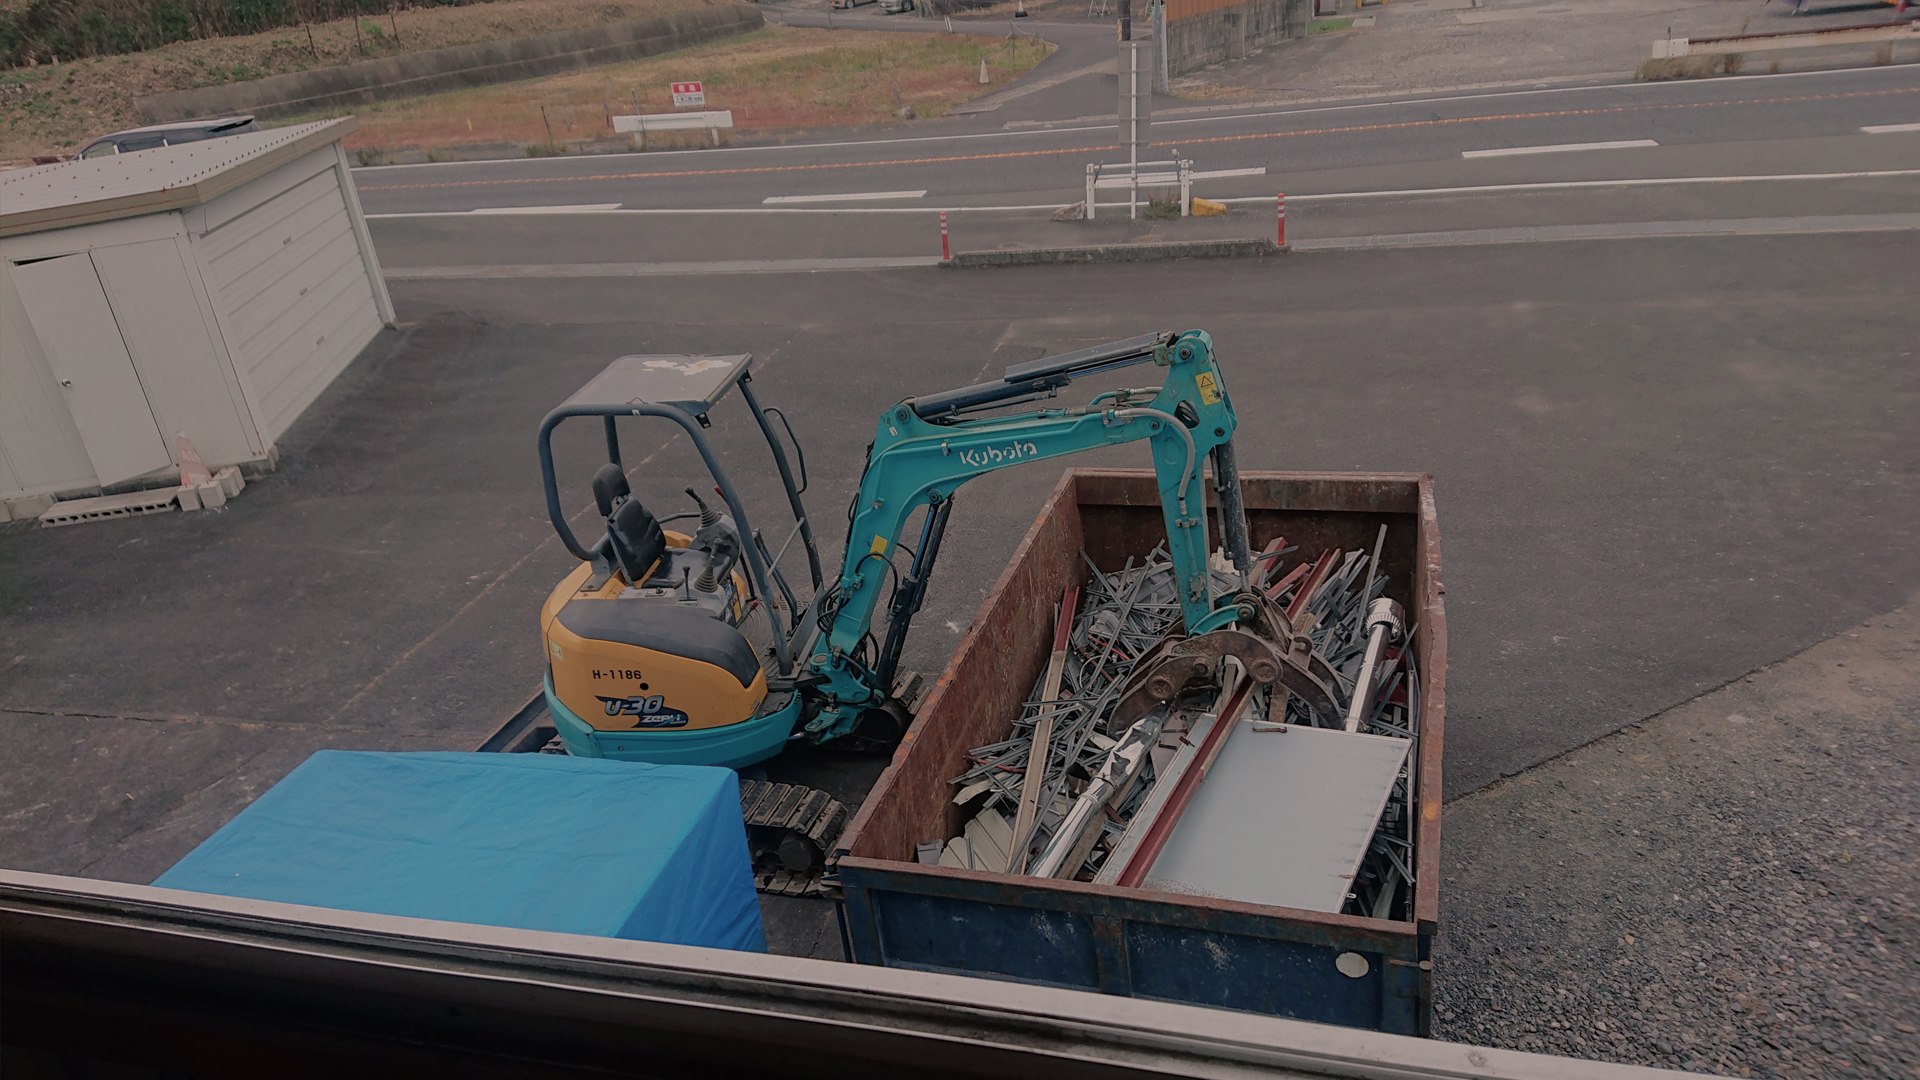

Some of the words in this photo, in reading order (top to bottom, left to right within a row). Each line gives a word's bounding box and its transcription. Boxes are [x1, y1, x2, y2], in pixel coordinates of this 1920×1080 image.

[960, 441, 1038, 467] Kubota
[592, 669, 642, 680] H-1186
[605, 695, 664, 716] U-30
